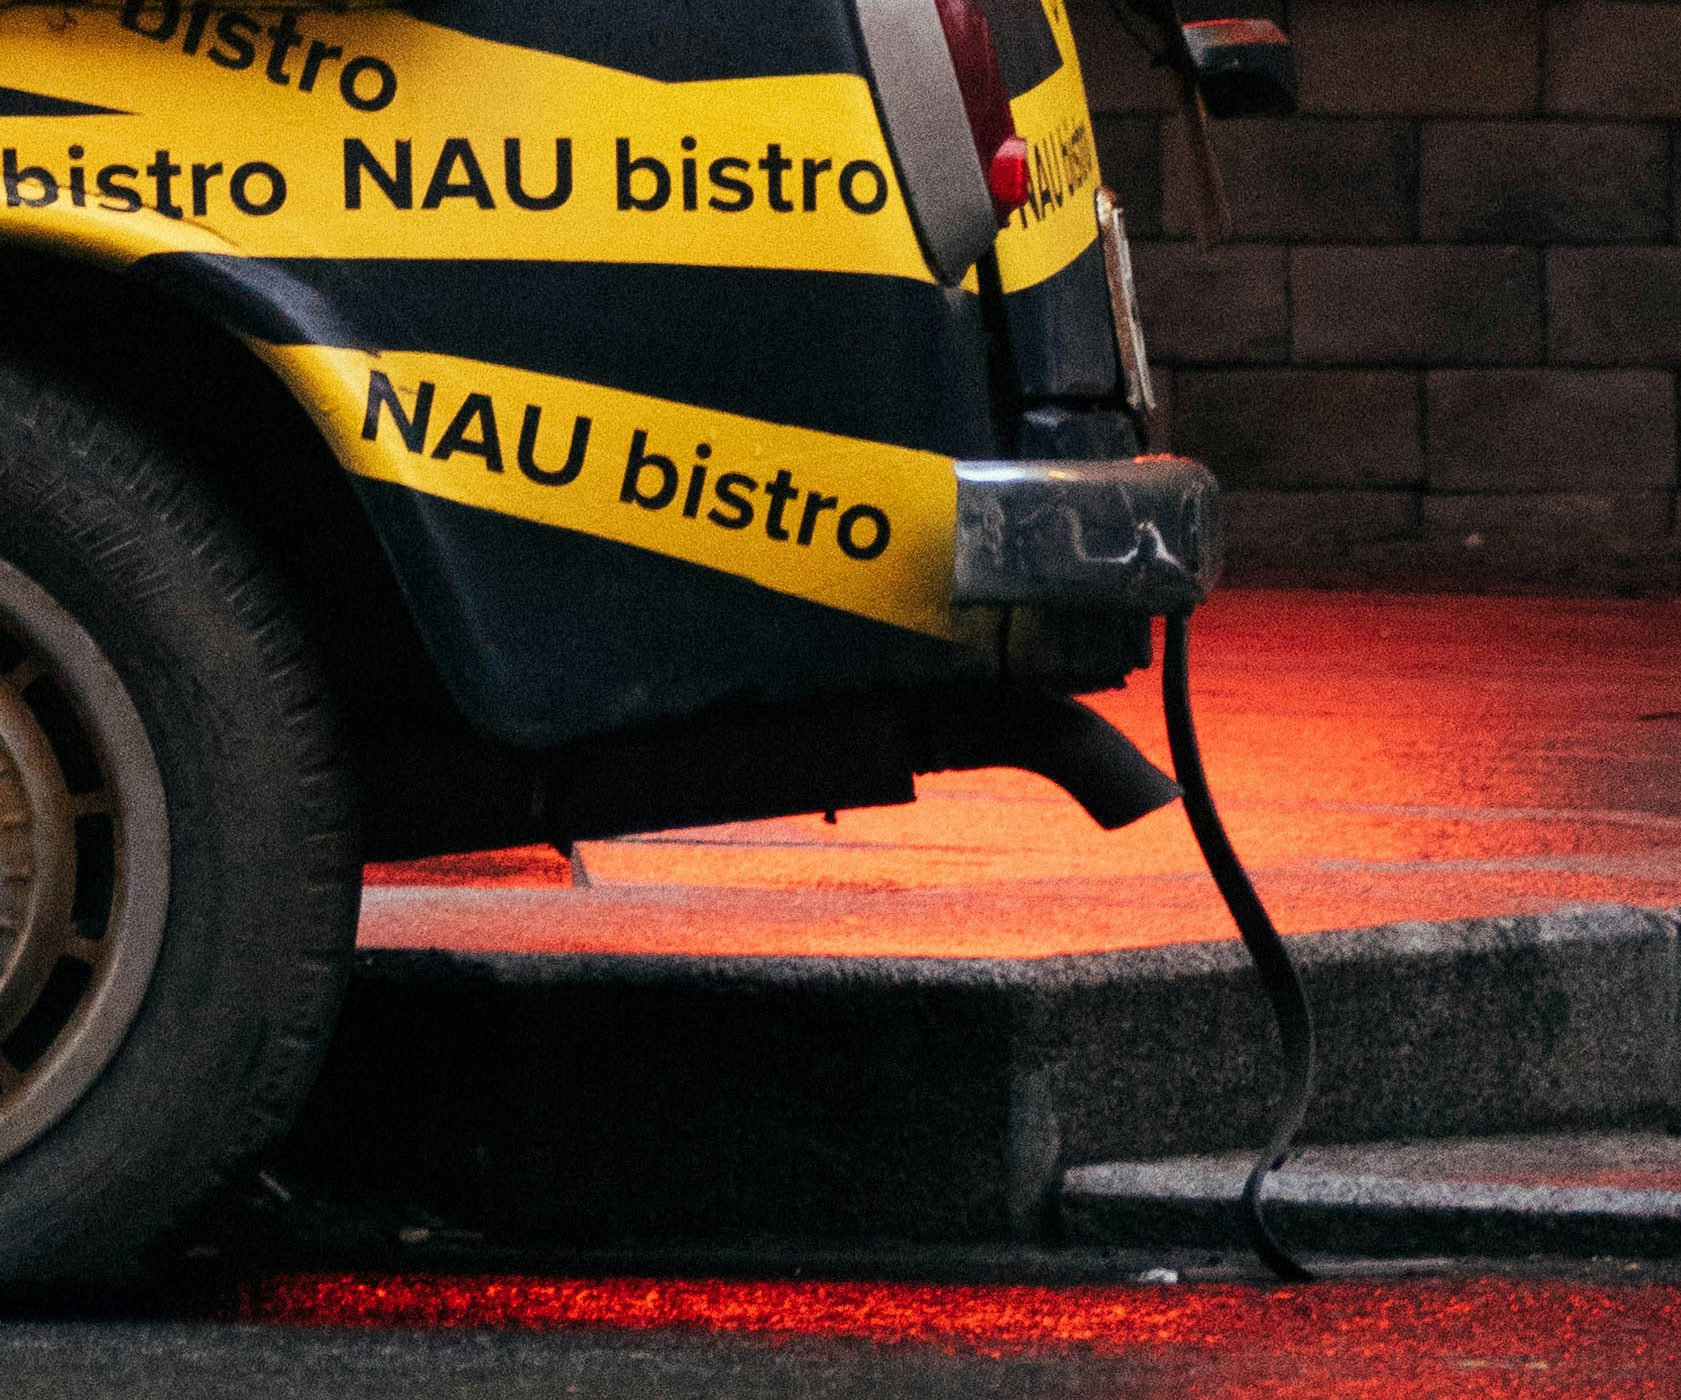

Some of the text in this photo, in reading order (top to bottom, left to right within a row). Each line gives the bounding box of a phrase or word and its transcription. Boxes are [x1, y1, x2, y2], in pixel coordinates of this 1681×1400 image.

[3, 143, 288, 220] bistro
[343, 136, 573, 212] NAU
[615, 135, 890, 215] bistro
[361, 369, 893, 562] NAU bistro
